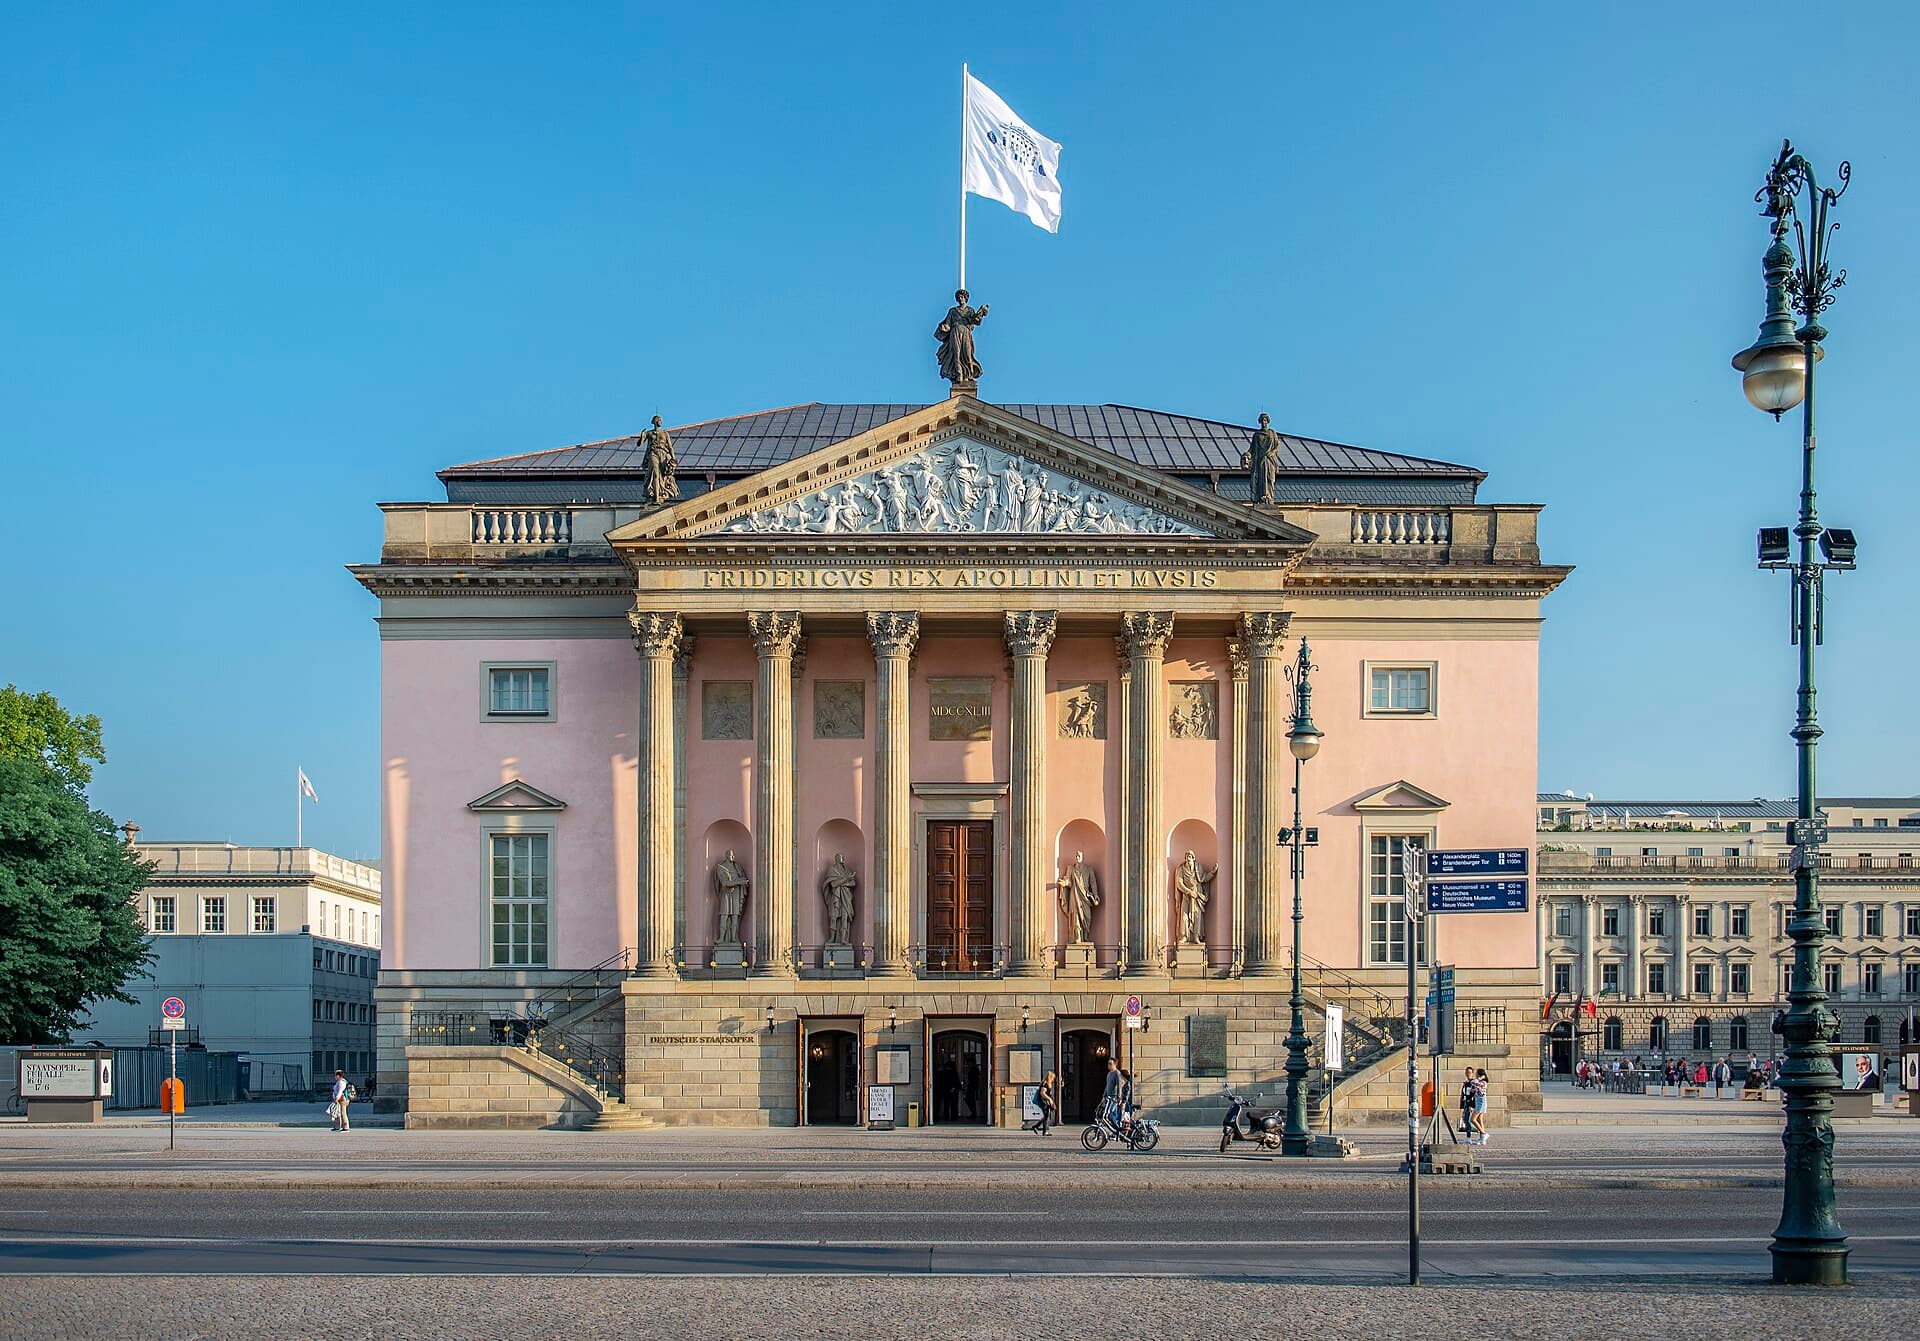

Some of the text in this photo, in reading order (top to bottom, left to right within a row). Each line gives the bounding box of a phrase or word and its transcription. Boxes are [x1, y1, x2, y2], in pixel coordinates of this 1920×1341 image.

[703, 570, 1217, 587] FRIDERICVS REX APOLLINI ET MVSIS
[931, 706, 990, 716] MDCCXLIII
[650, 1036, 754, 1044] DEUTSCHE STAATSOPER
